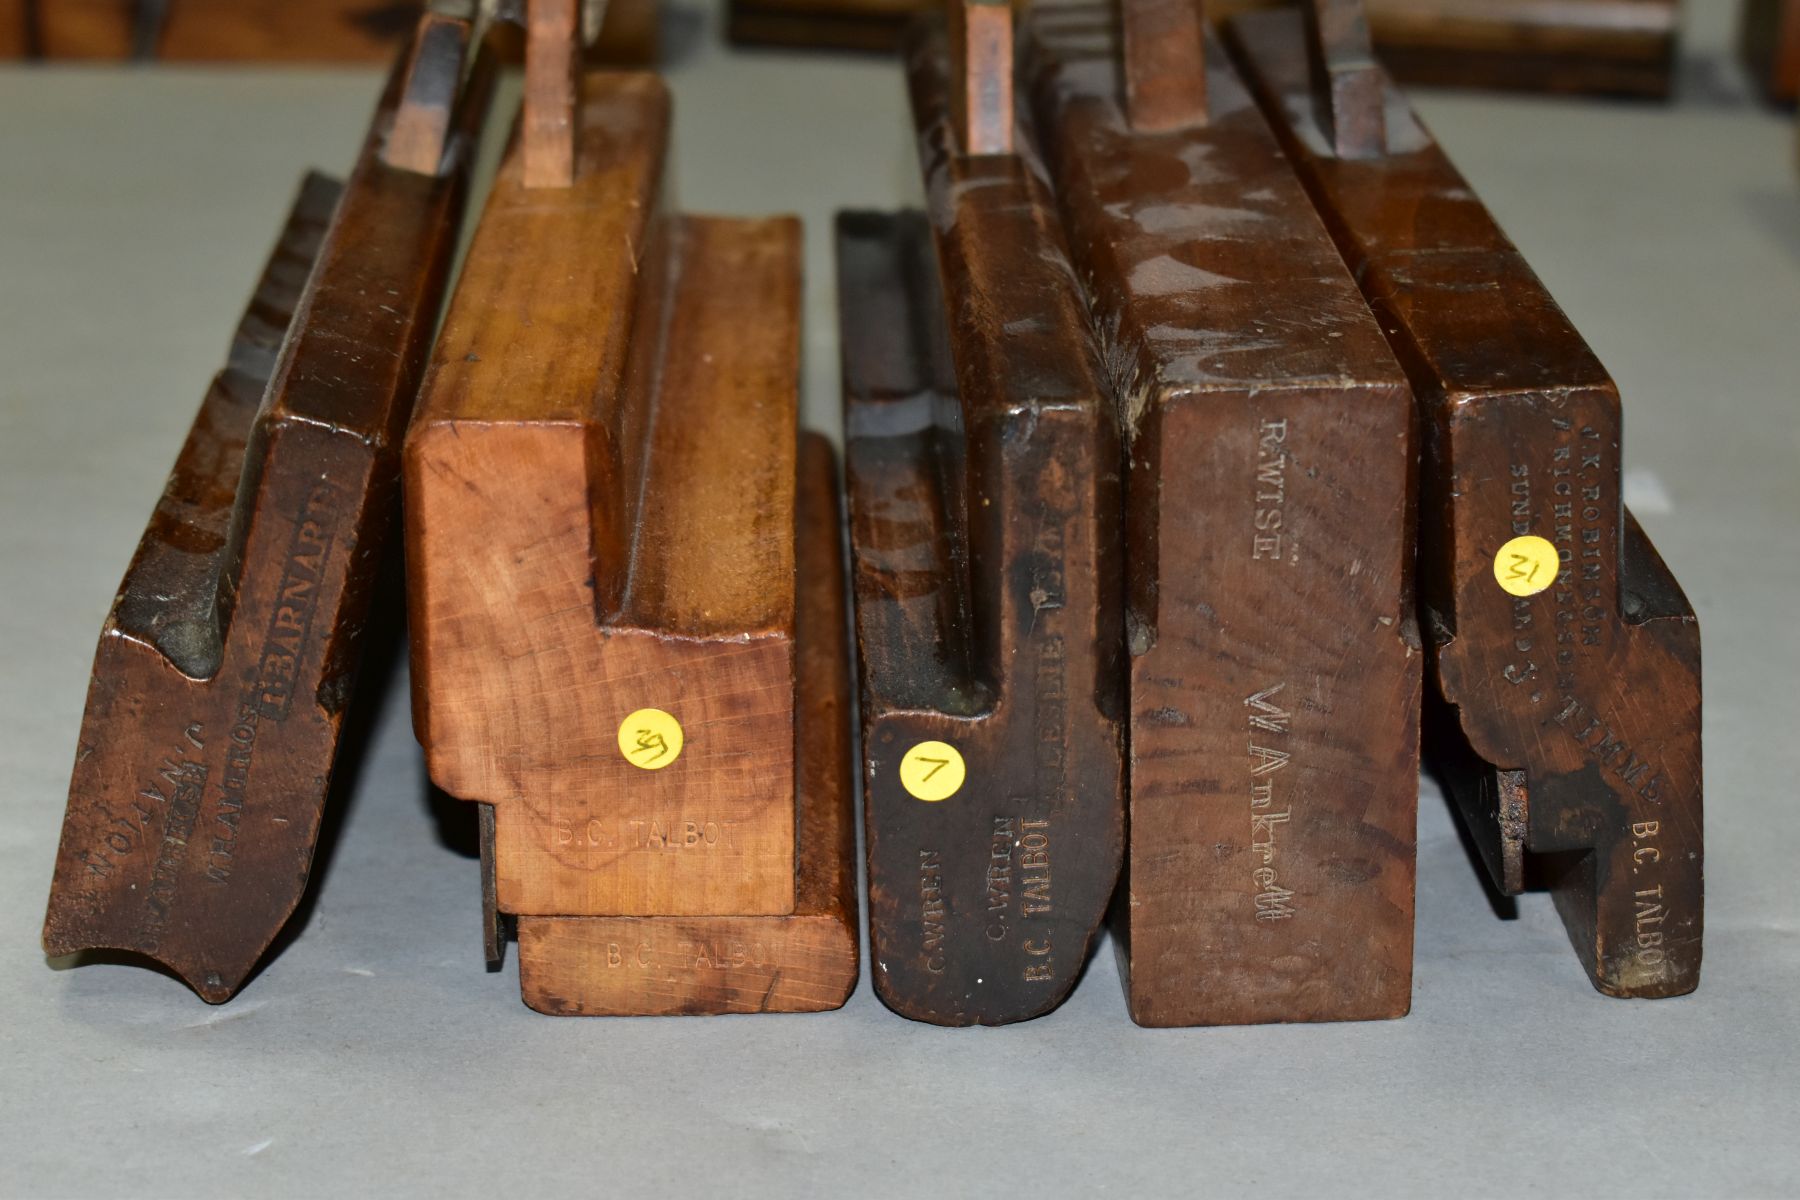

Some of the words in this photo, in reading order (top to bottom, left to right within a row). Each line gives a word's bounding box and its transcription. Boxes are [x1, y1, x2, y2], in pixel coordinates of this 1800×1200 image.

[1251, 417, 1287, 559] R.WISE
[915, 757, 949, 782] 7
[631, 820, 738, 849] TALBOT
[1019, 816, 1050, 917] TALBOT
[1633, 883, 1666, 980] TALBOT
